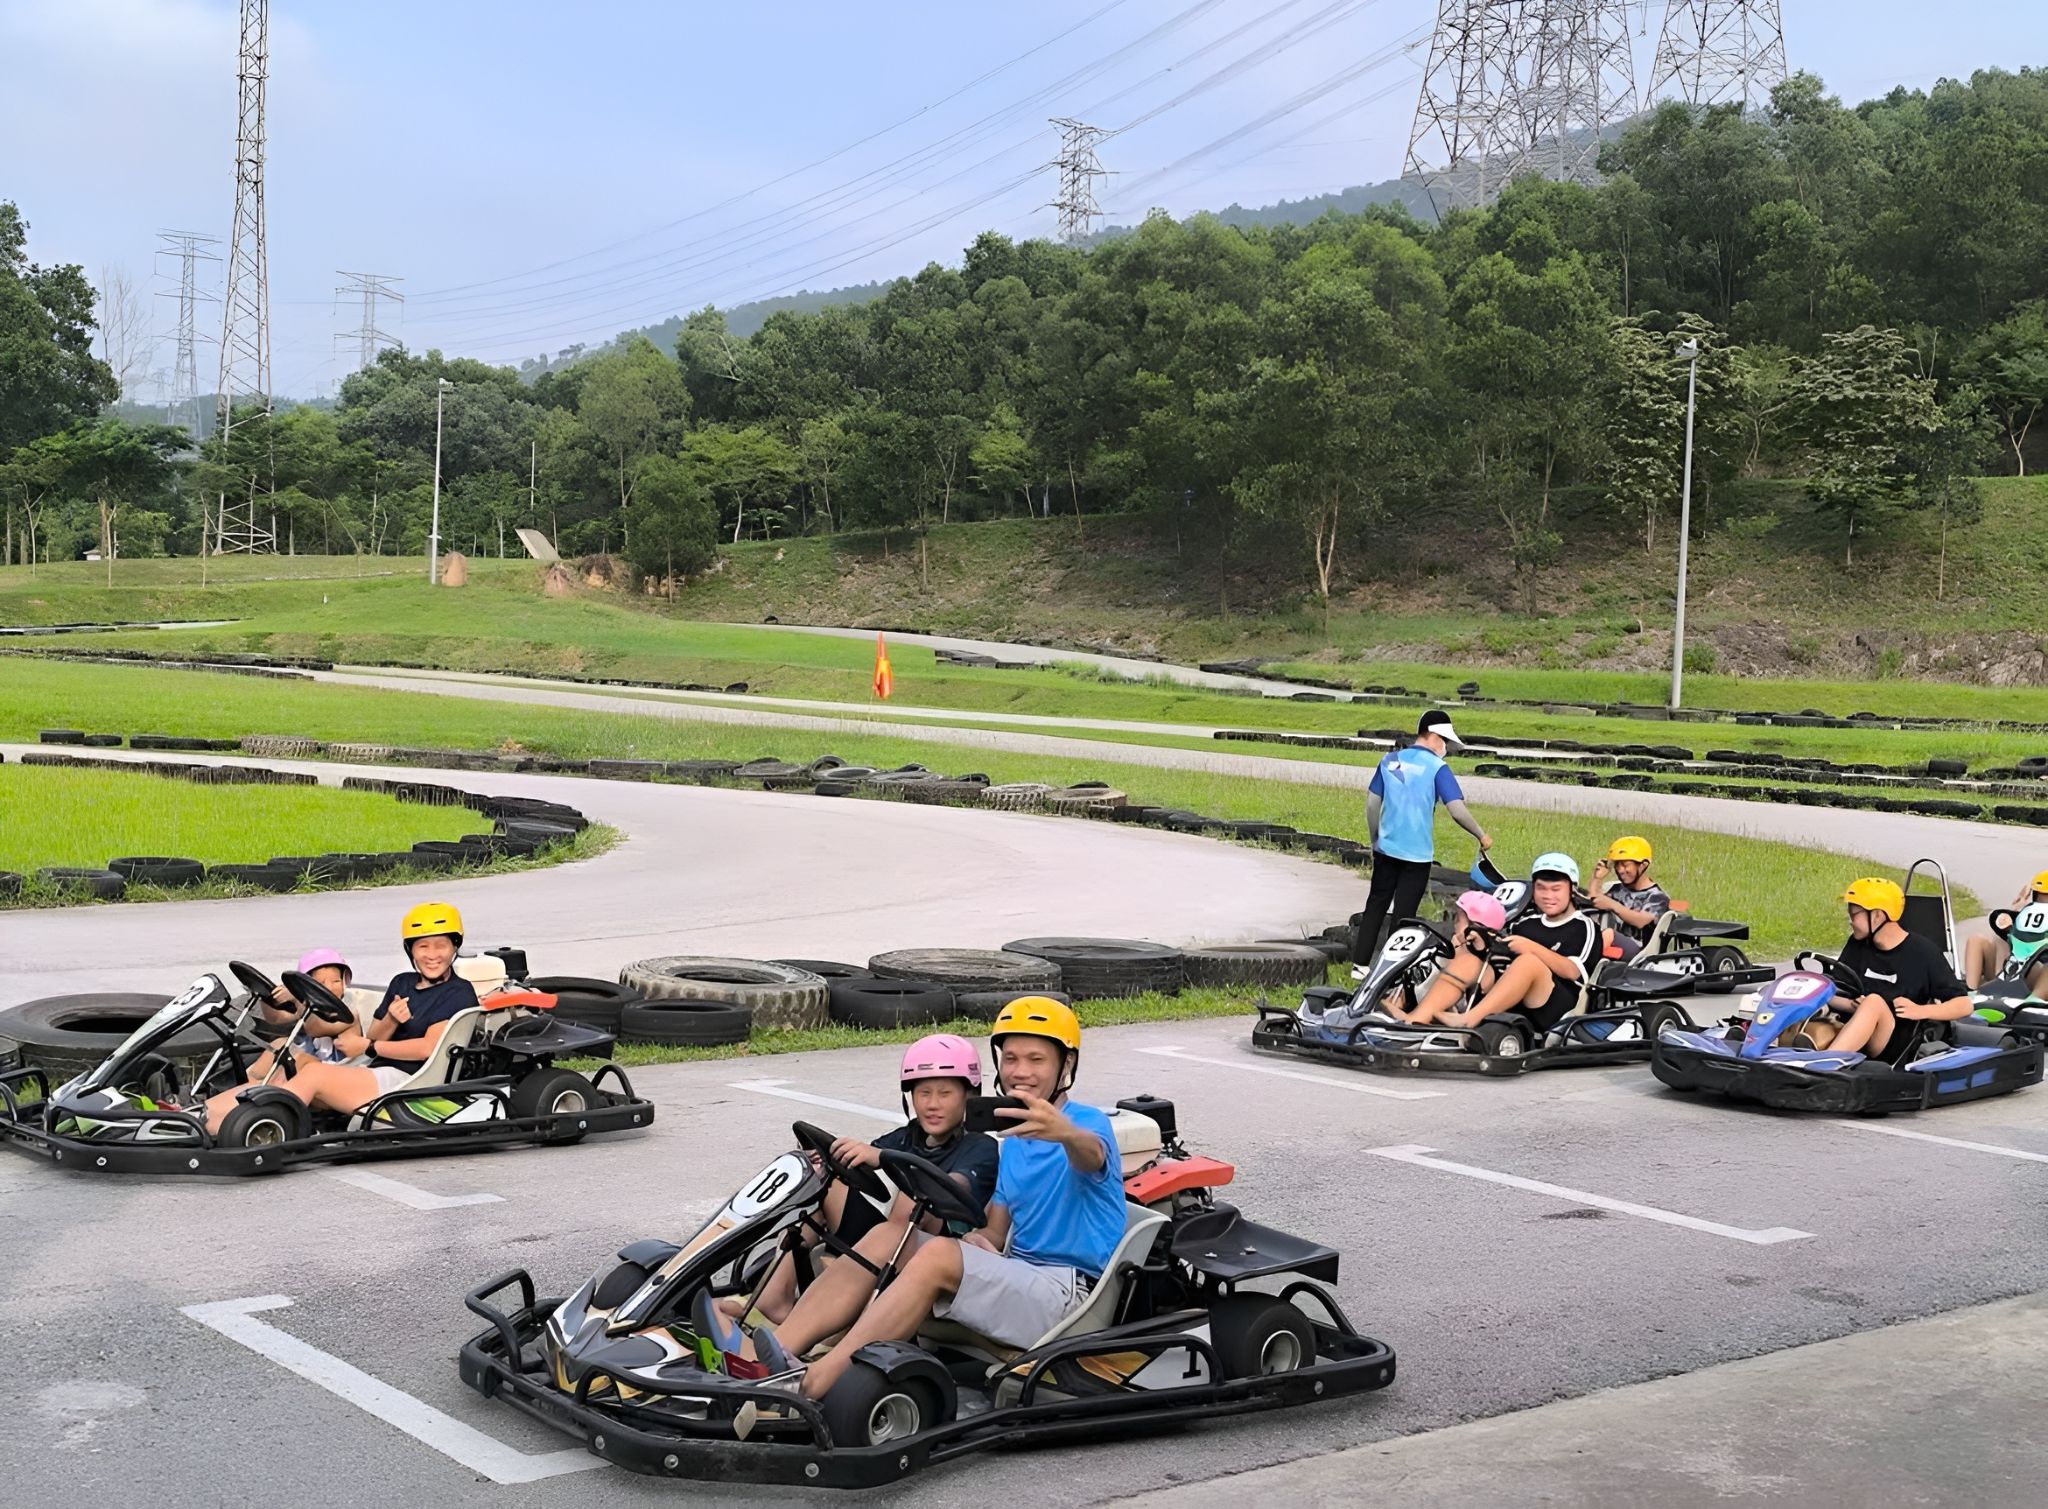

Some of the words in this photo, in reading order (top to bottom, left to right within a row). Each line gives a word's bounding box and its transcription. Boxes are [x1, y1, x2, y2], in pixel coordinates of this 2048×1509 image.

[2024, 912, 2045, 928] 19
[1388, 936, 1416, 951] 22
[746, 1167, 790, 1203] 18
